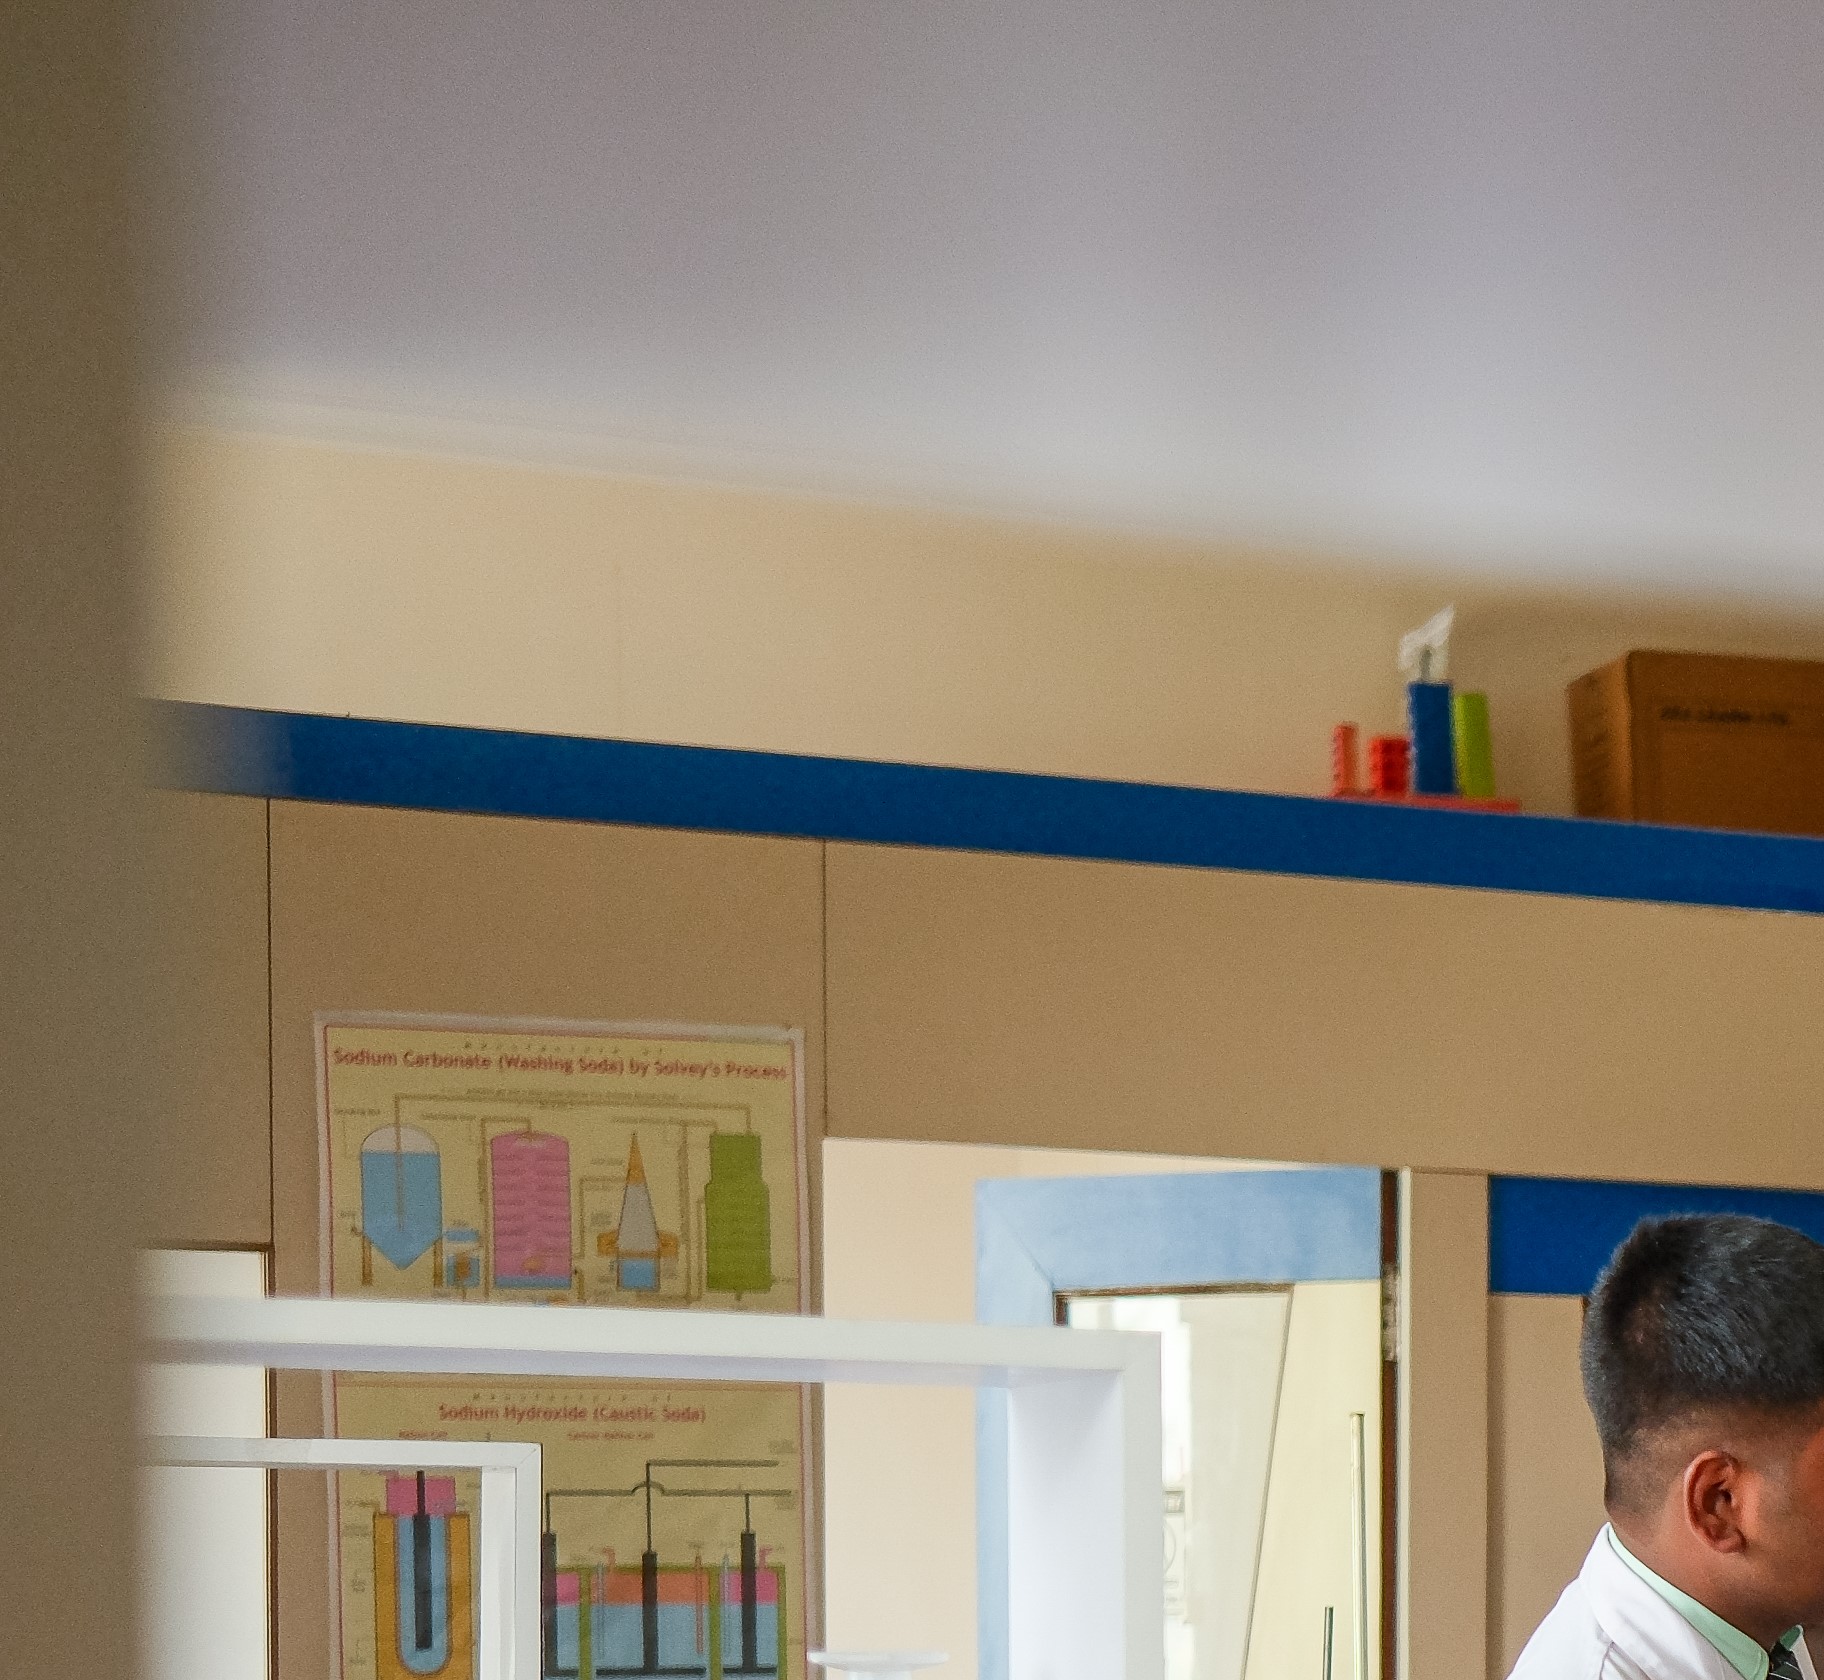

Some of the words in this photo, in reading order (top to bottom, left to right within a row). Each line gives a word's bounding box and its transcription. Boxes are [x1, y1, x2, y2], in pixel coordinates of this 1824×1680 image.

[333, 1046, 398, 1067] Sodium
[402, 1050, 492, 1070] Carbonate
[498, 1053, 574, 1076] (Washing
[579, 1057, 625, 1077] Soda)
[629, 1058, 649, 1078] by
[725, 1060, 788, 1080] Process
[438, 1403, 499, 1421] Sodium
[504, 1404, 588, 1424] Hydroxide
[592, 1405, 655, 1423] (Caustic
[661, 1405, 706, 1423] Soda)
